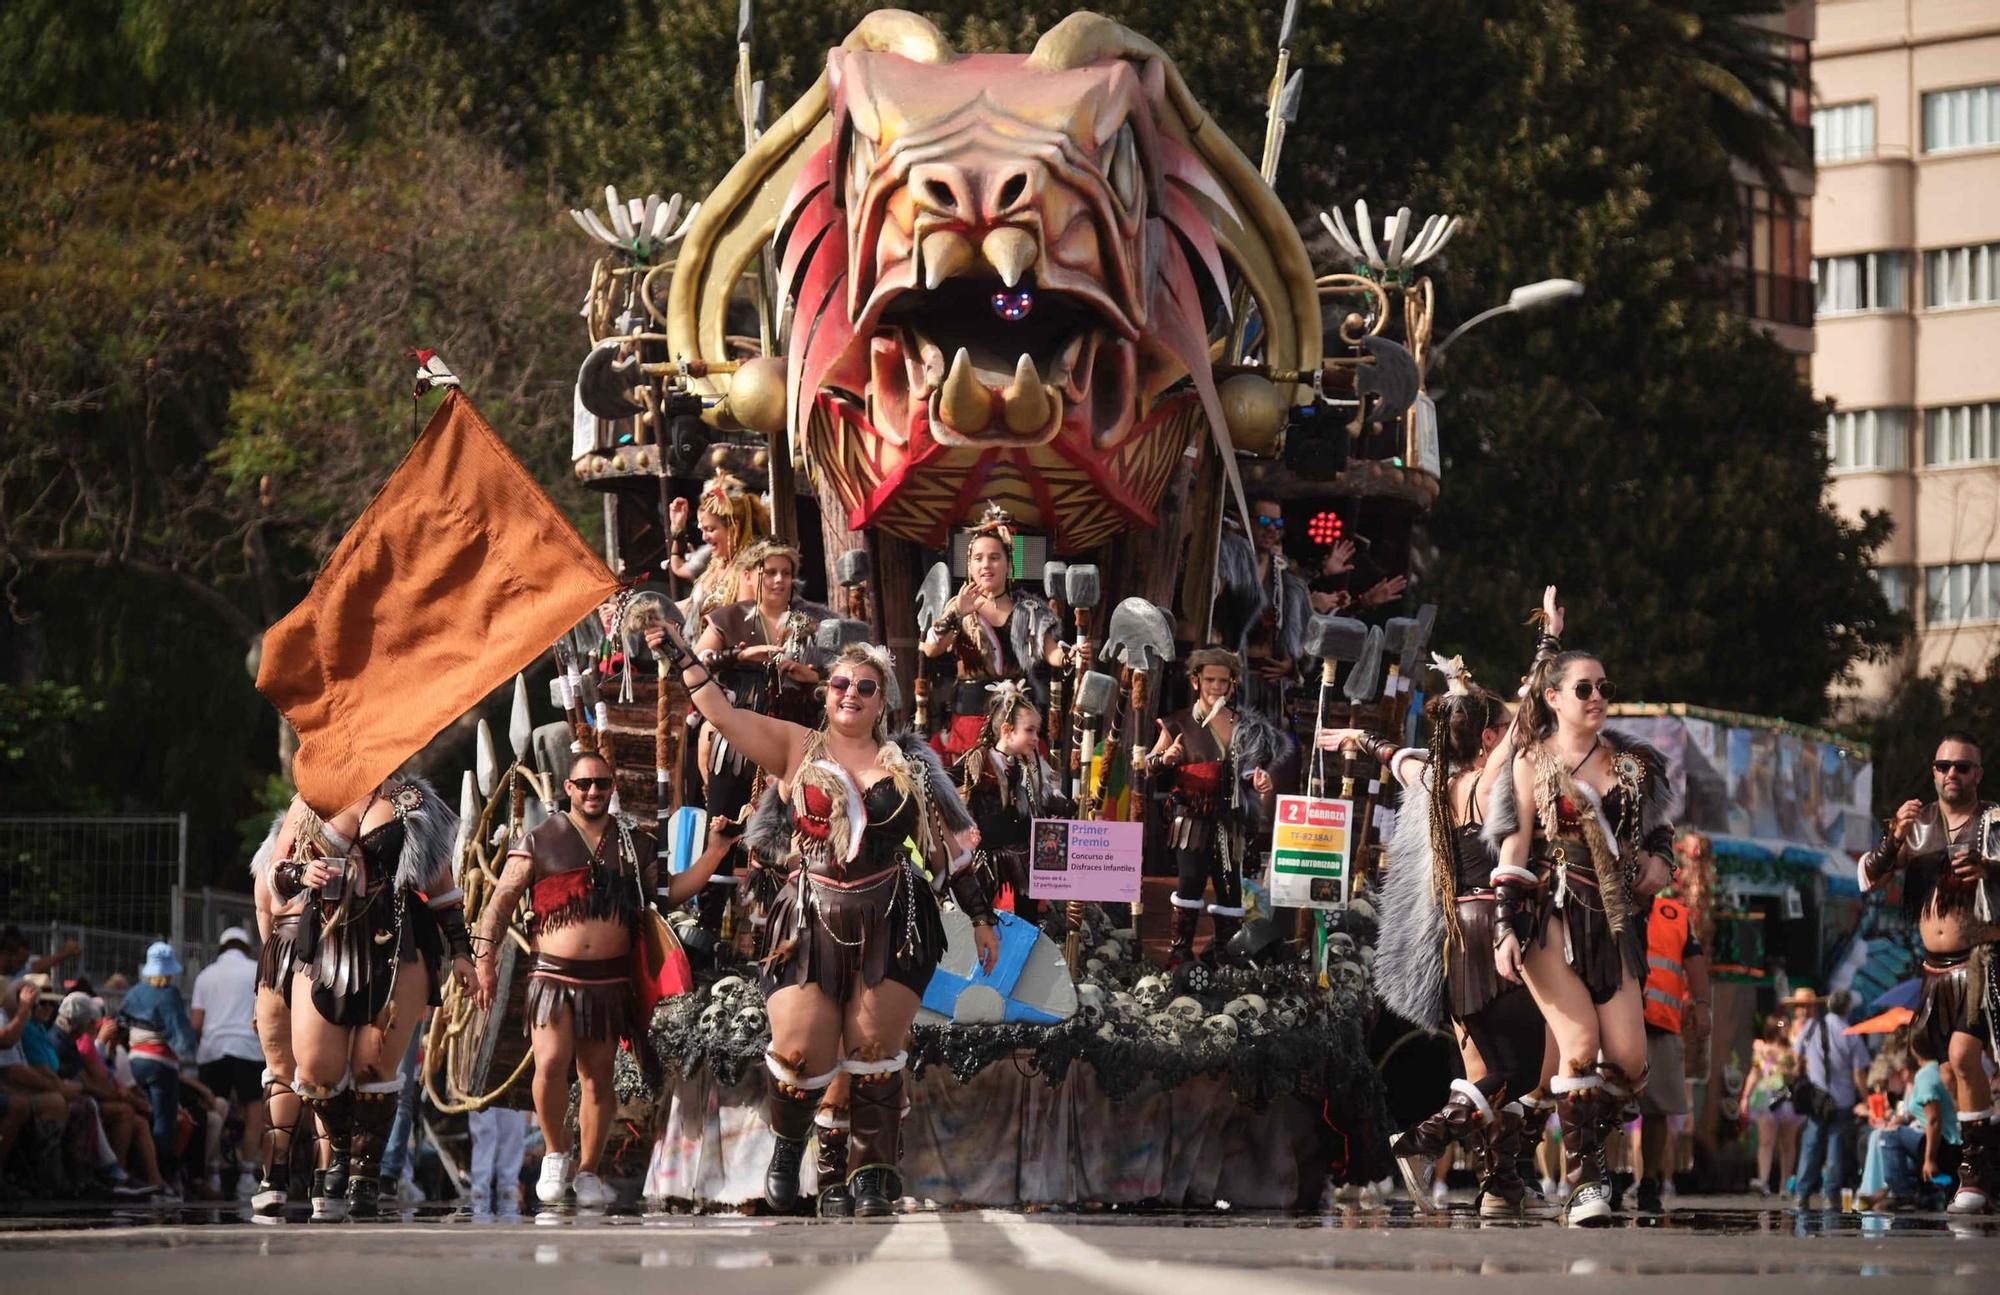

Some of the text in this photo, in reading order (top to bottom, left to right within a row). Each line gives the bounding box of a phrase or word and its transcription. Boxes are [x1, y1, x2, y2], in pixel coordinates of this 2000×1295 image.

[1288, 804, 1298, 821] 2
[1309, 808, 1345, 821] CARROZA
[1072, 824, 1108, 835] Primer
[1071, 837, 1110, 847] Premio
[1071, 852, 1114, 861] Concurso de
[1071, 863, 1136, 873] Disfraces Infantiles
[1277, 857, 1341, 870] SONIDO AUTORIZADO
